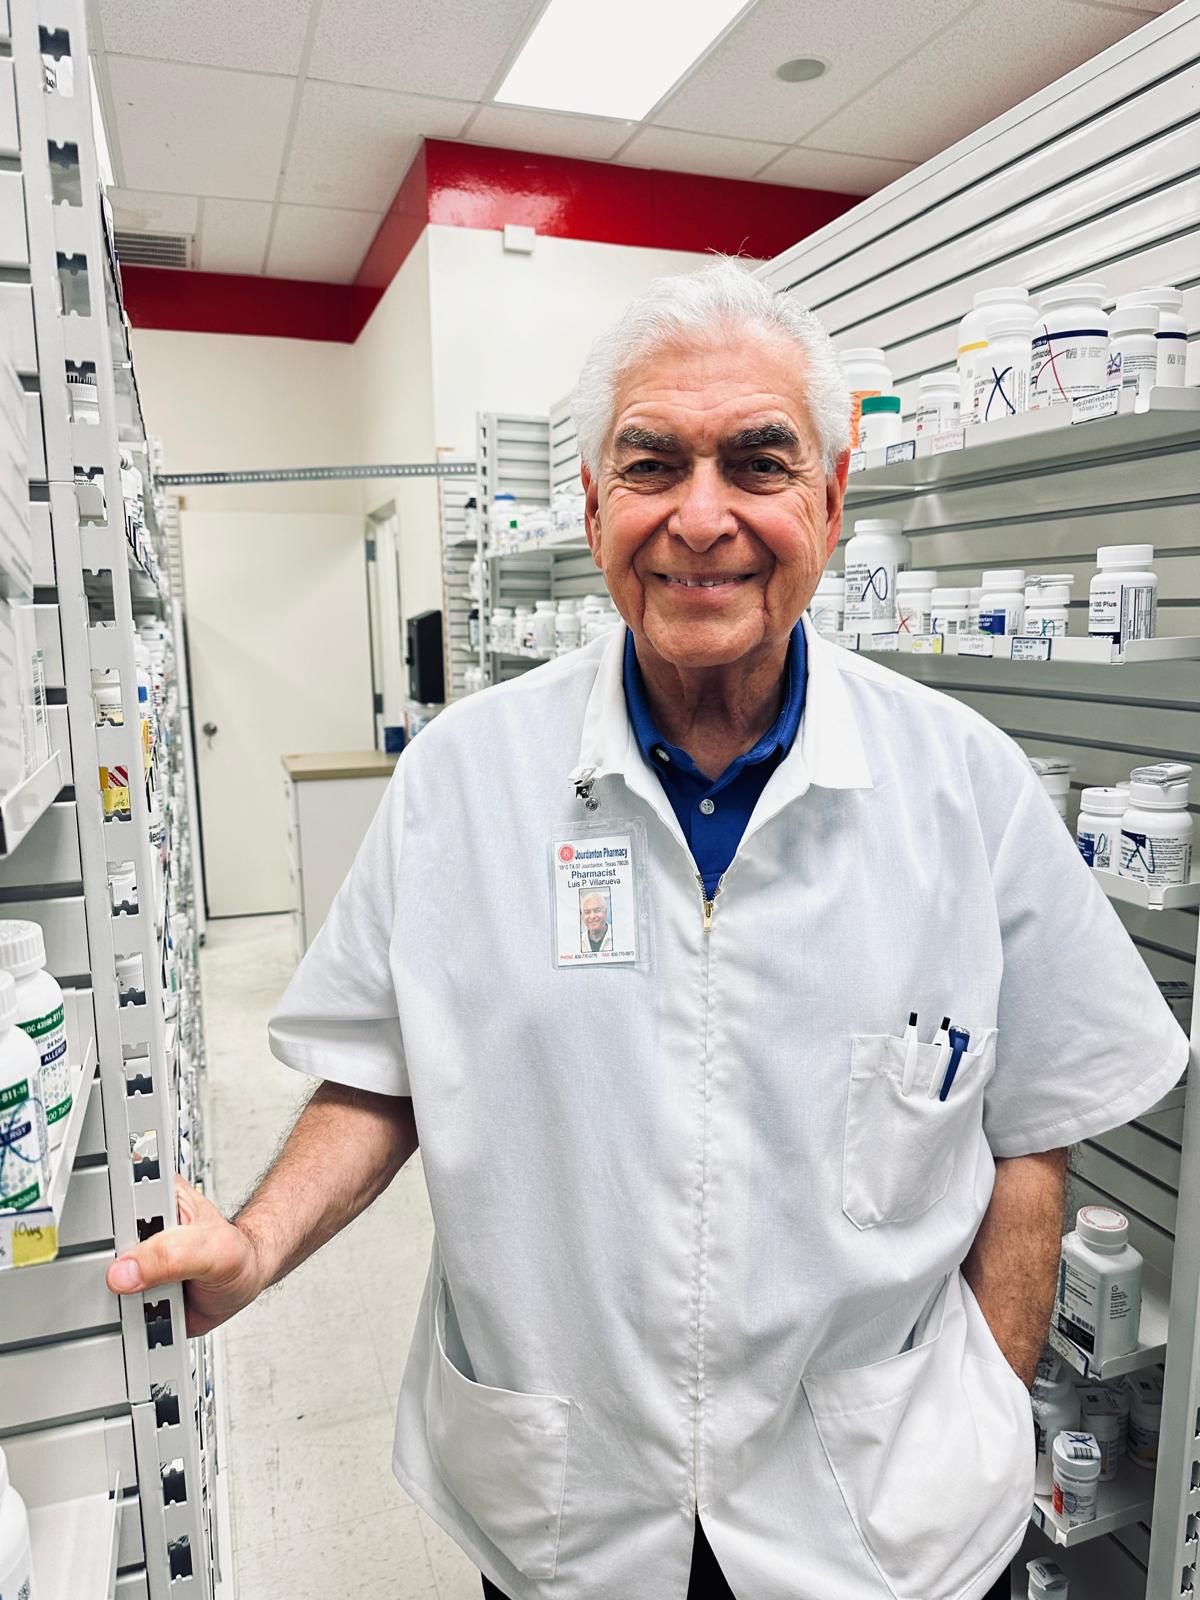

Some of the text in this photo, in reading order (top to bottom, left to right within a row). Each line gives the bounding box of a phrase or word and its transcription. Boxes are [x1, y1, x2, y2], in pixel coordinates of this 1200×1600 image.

[575, 847, 628, 860] Jourdanton Pharmacy
[571, 868, 616, 879] Pharmacist
[581, 879, 588, 887] P.
[589, 878, 621, 887] Villanueva
[44, 1043, 66, 1063] ALLERGY
